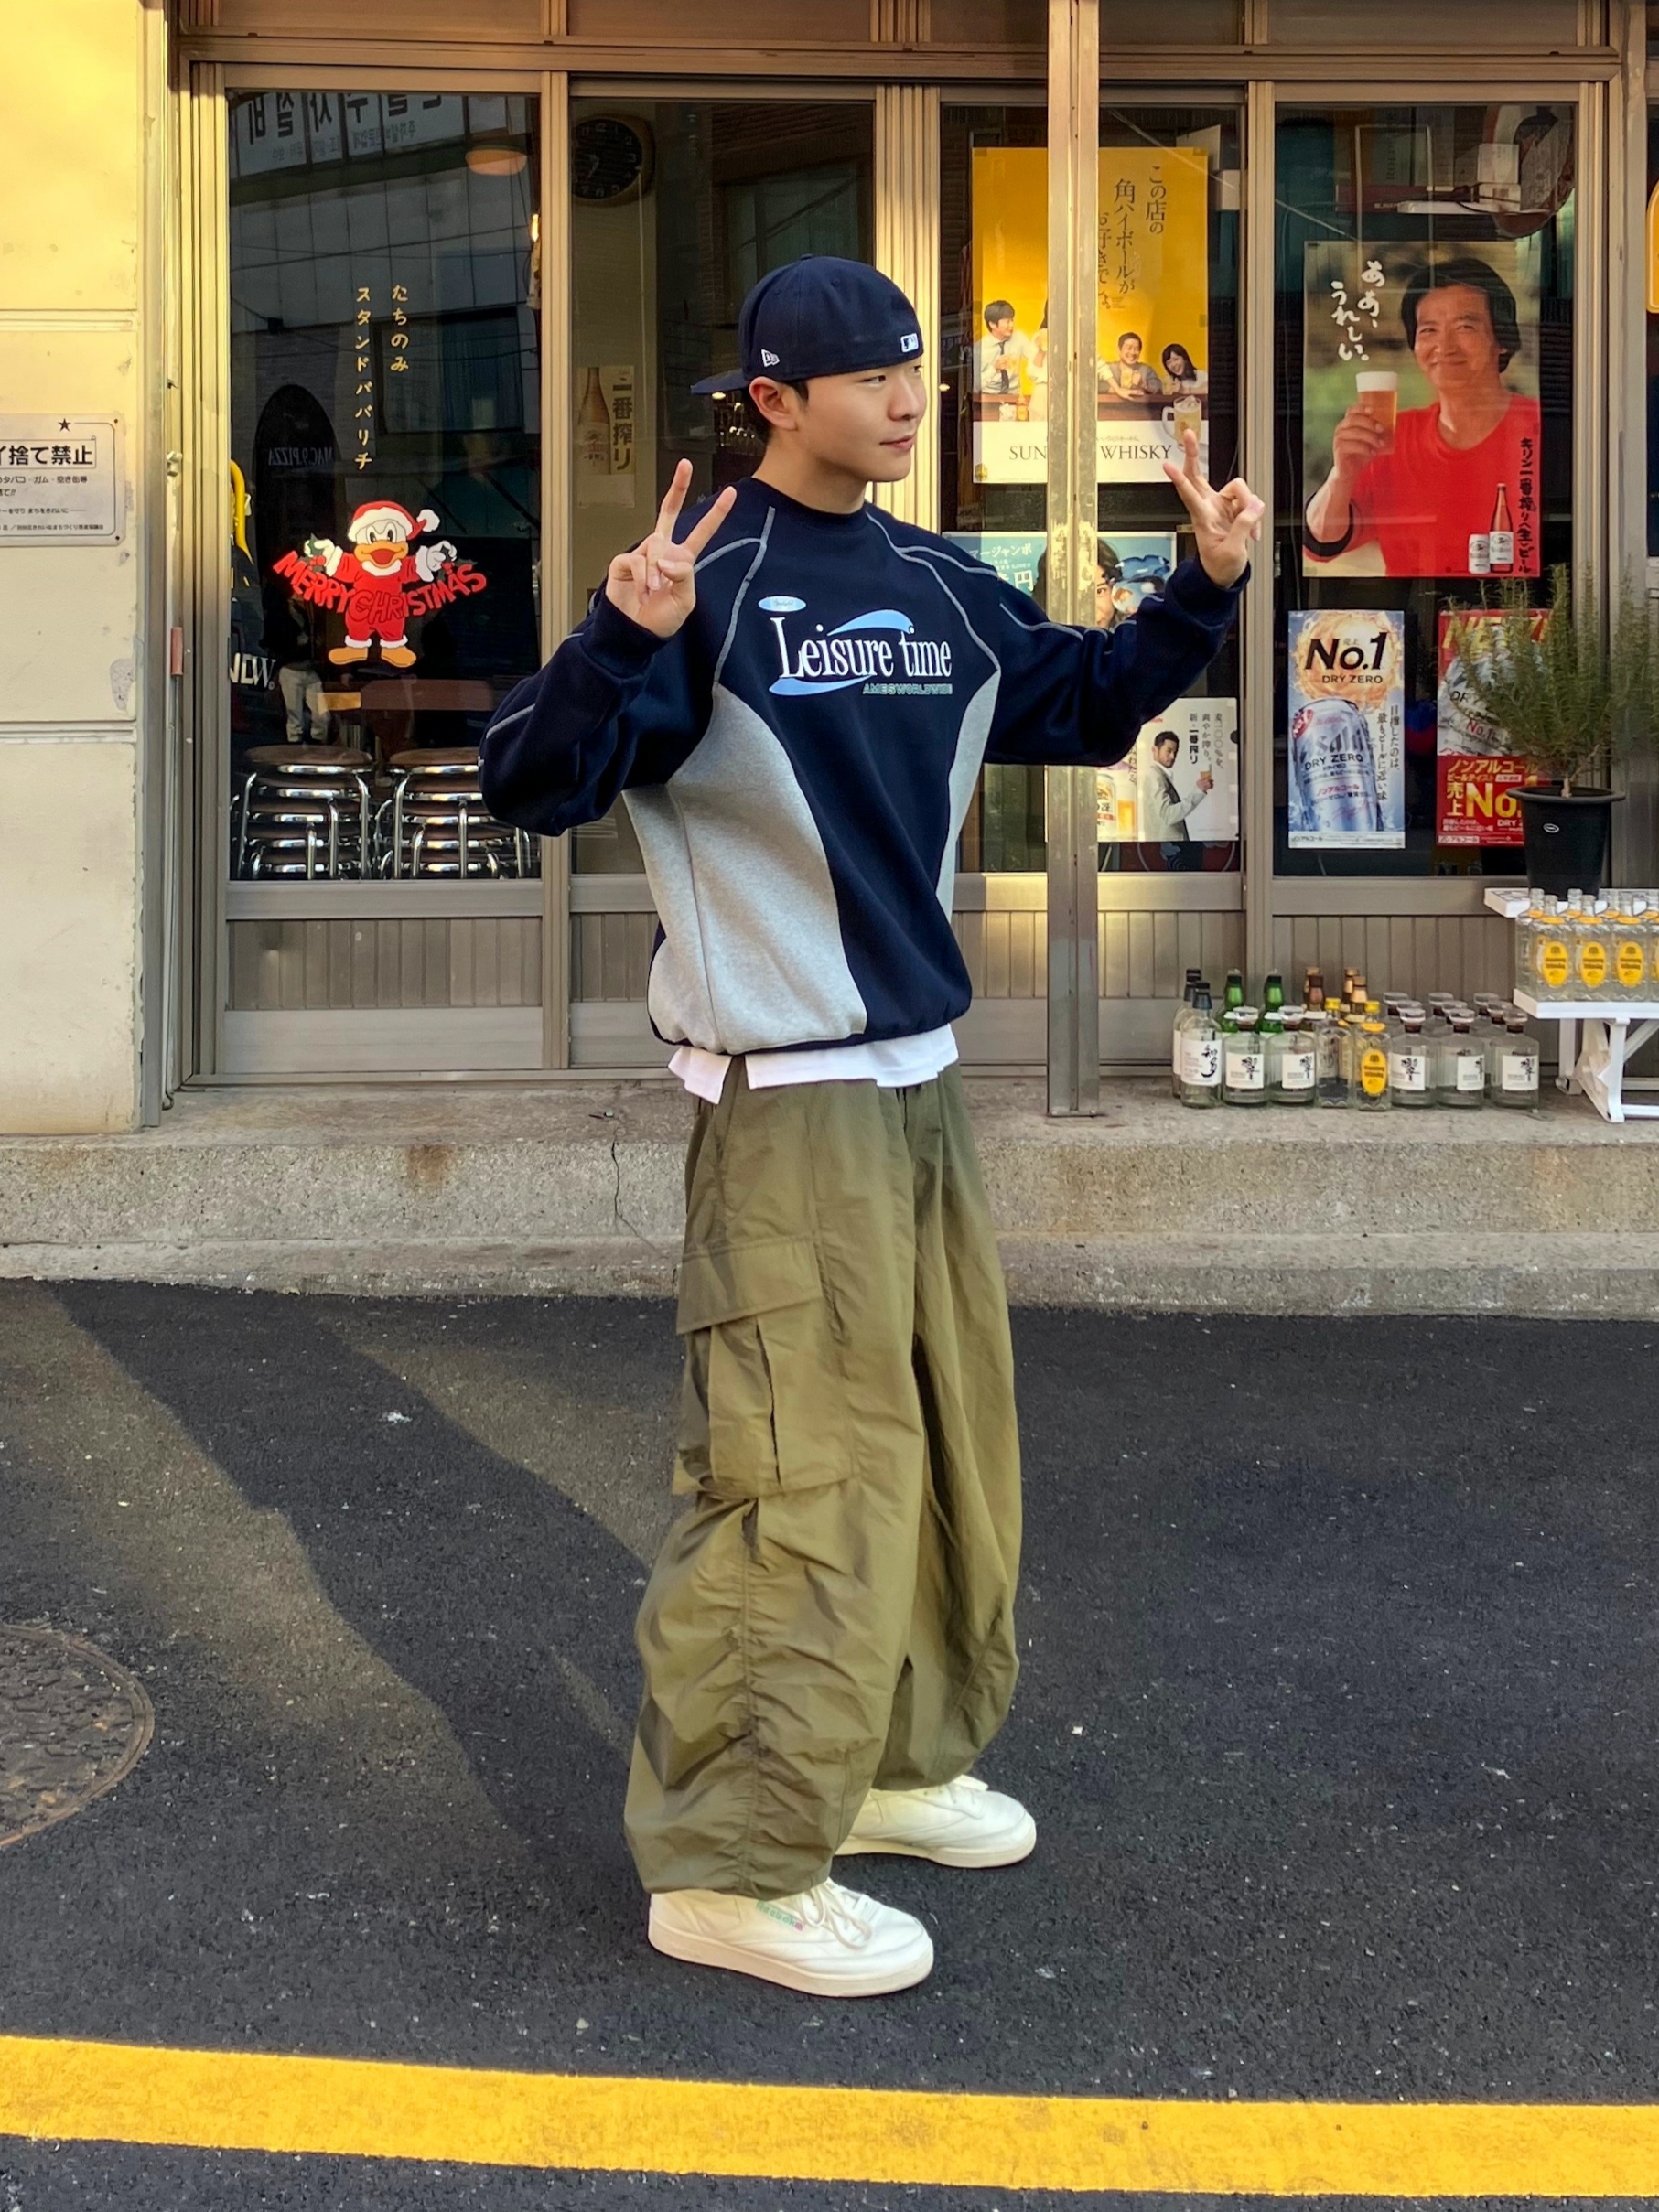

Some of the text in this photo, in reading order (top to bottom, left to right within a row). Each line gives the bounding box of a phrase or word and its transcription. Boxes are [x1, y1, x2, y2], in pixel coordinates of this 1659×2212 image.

[1146, 166, 1166, 235] この店の
[1114, 178, 1135, 295] 角ハイボールが
[391, 285, 409, 371] たちのみ
[613, 384, 632, 470] 一番搾り
[1100, 444, 1172, 460] WHISKY
[273, 551, 487, 625] MERRY CHRISTMAS
[770, 617, 952, 678] Leisure time
[1304, 631, 1388, 670] No.1
[1321, 675, 1384, 683] DRY ZERO
[1330, 753, 1363, 763] ZERO
